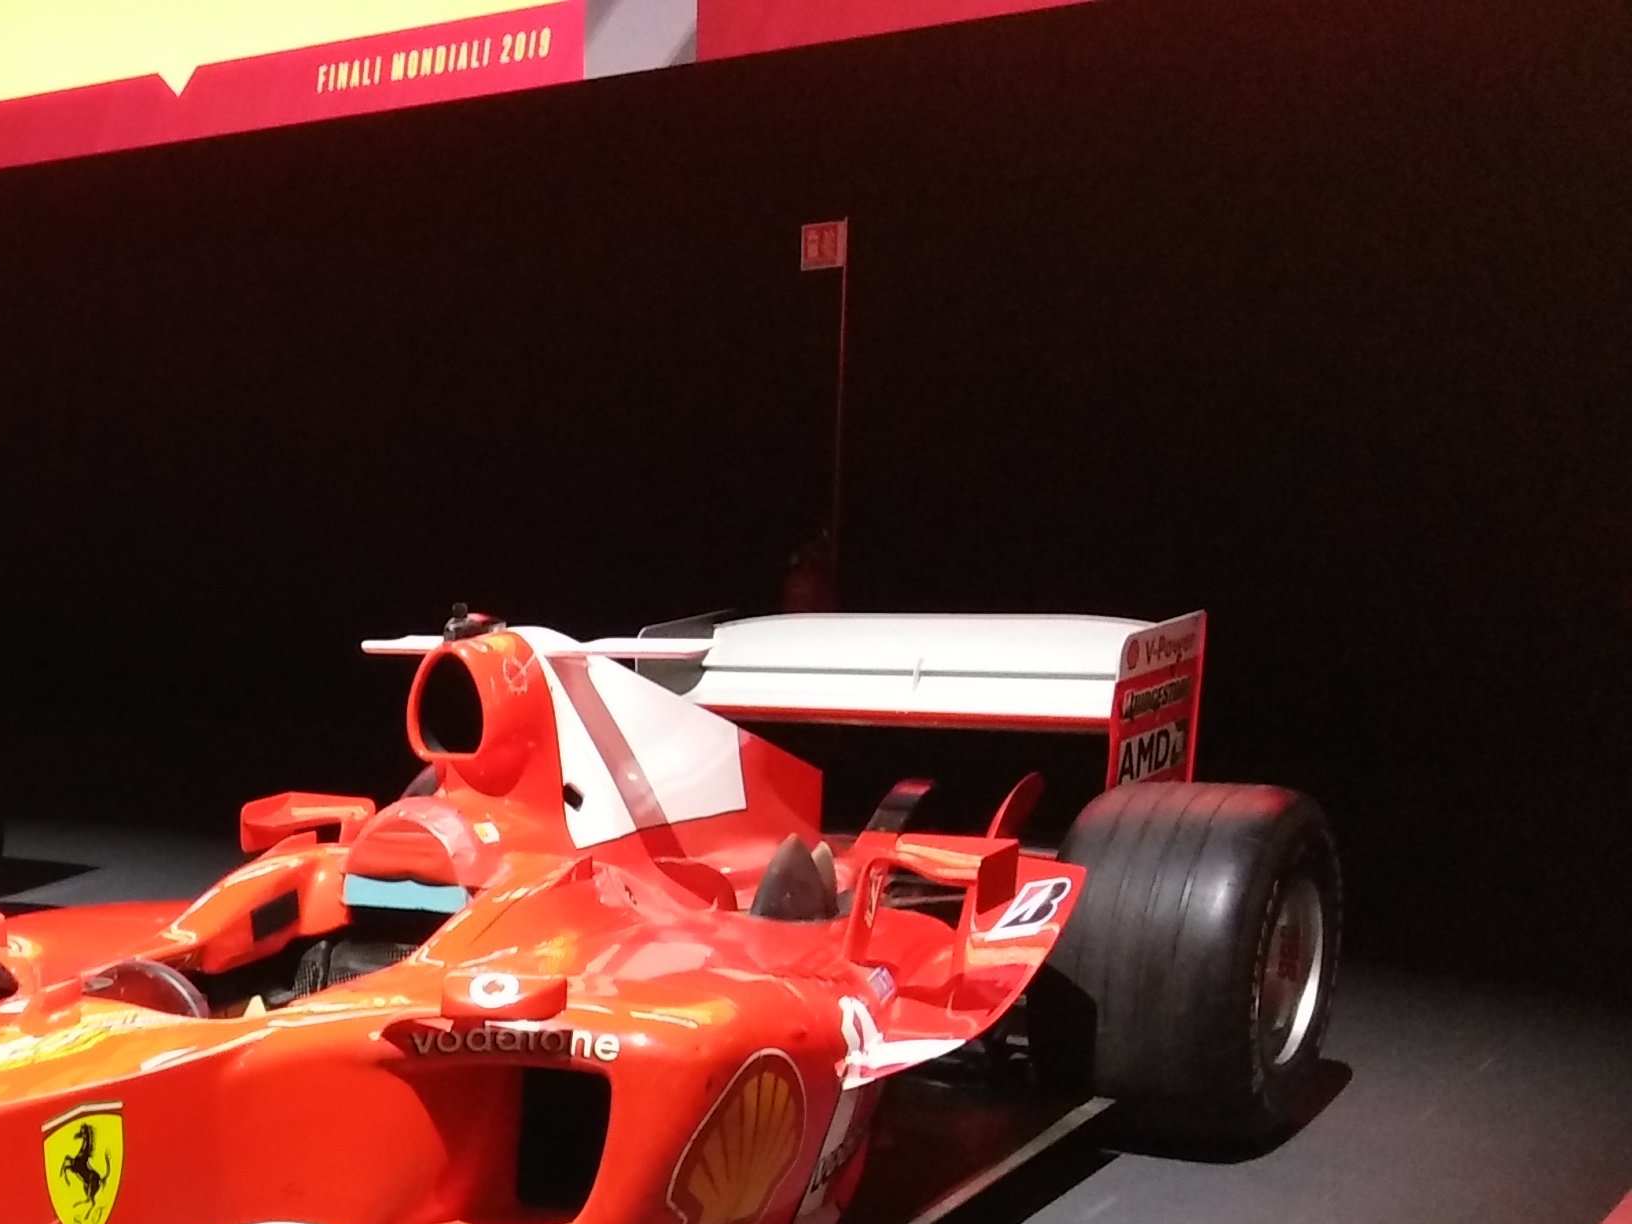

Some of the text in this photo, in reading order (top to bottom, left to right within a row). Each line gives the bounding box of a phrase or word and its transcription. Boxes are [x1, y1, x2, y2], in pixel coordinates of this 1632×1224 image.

[316, 26, 552, 94] FINALI MONDIALI 2019
[1119, 729, 1170, 785] AMD
[411, 1025, 620, 1062] vodafone
